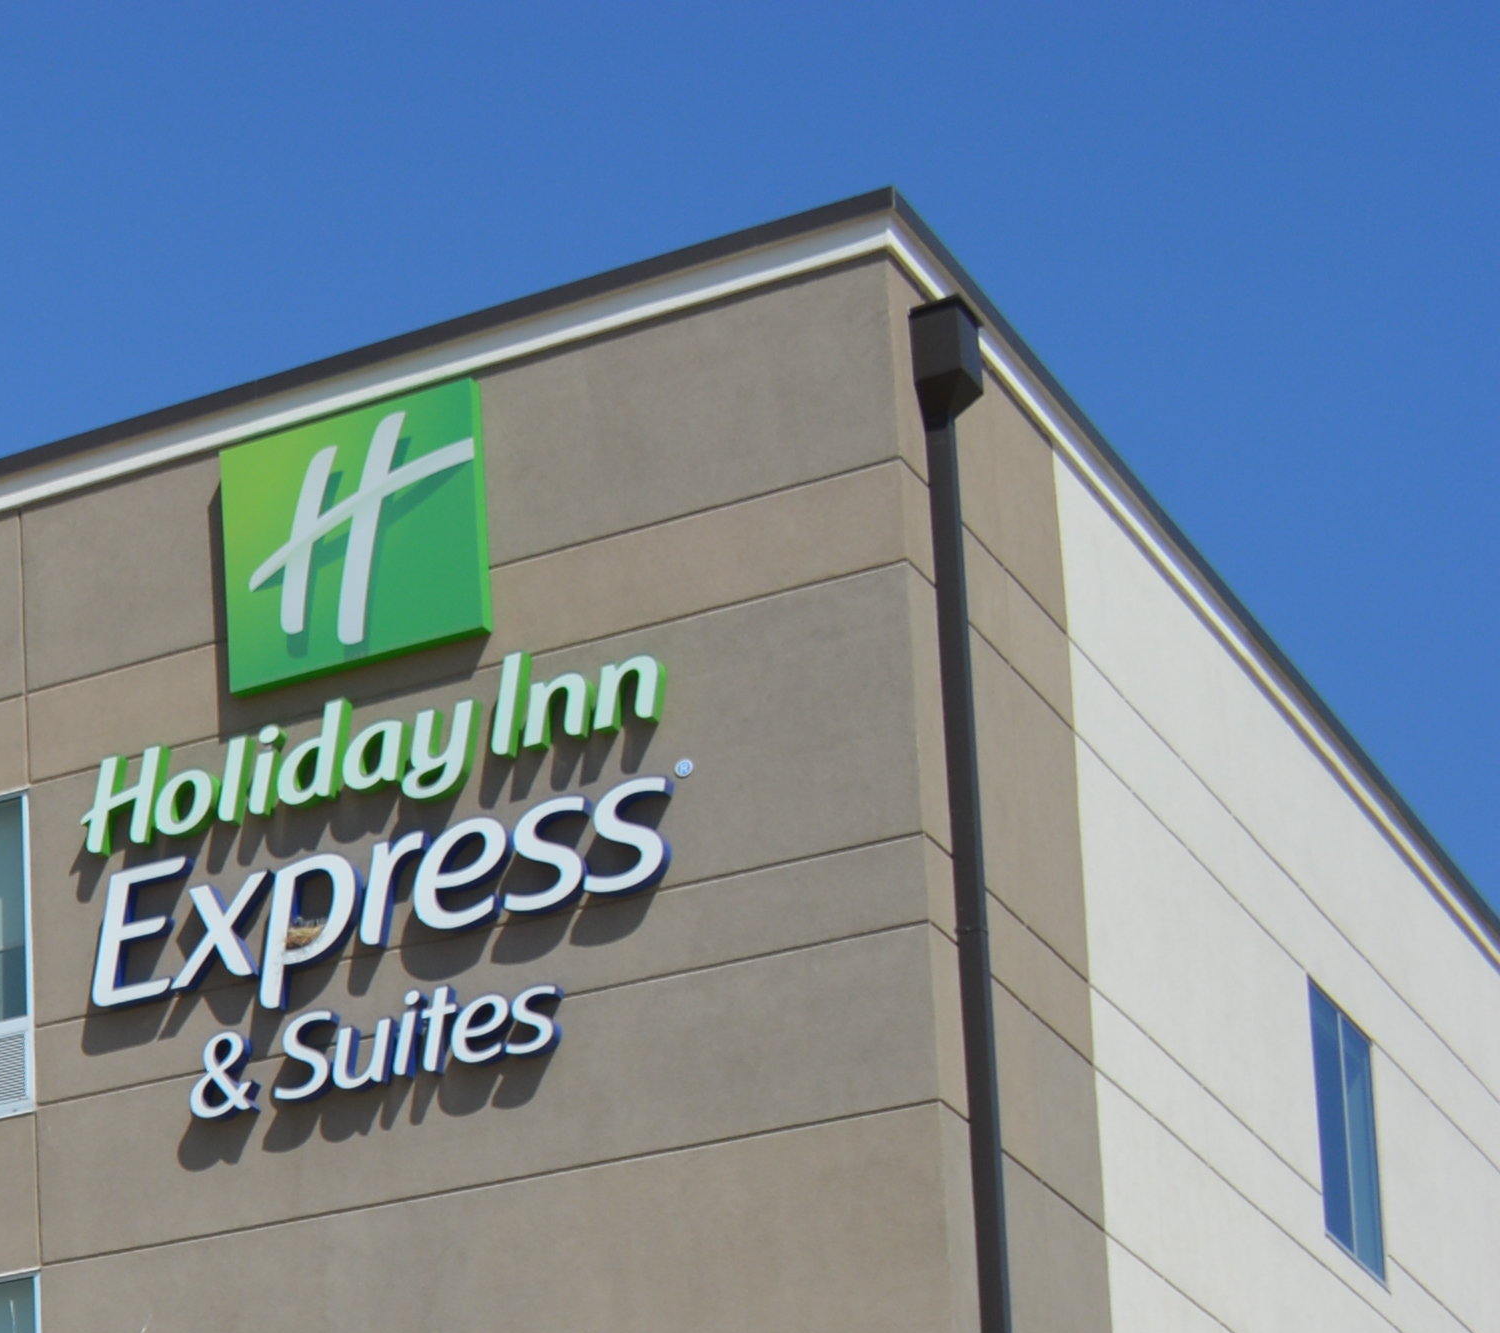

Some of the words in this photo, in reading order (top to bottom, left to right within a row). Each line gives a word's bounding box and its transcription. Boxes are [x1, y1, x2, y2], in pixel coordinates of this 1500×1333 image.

[249, 410, 475, 645] H
[80, 698, 482, 856] Holiday
[491, 651, 667, 758] Inn
[92, 776, 673, 1010] Express
[190, 1031, 260, 1119] &
[274, 984, 563, 1100] Suites
